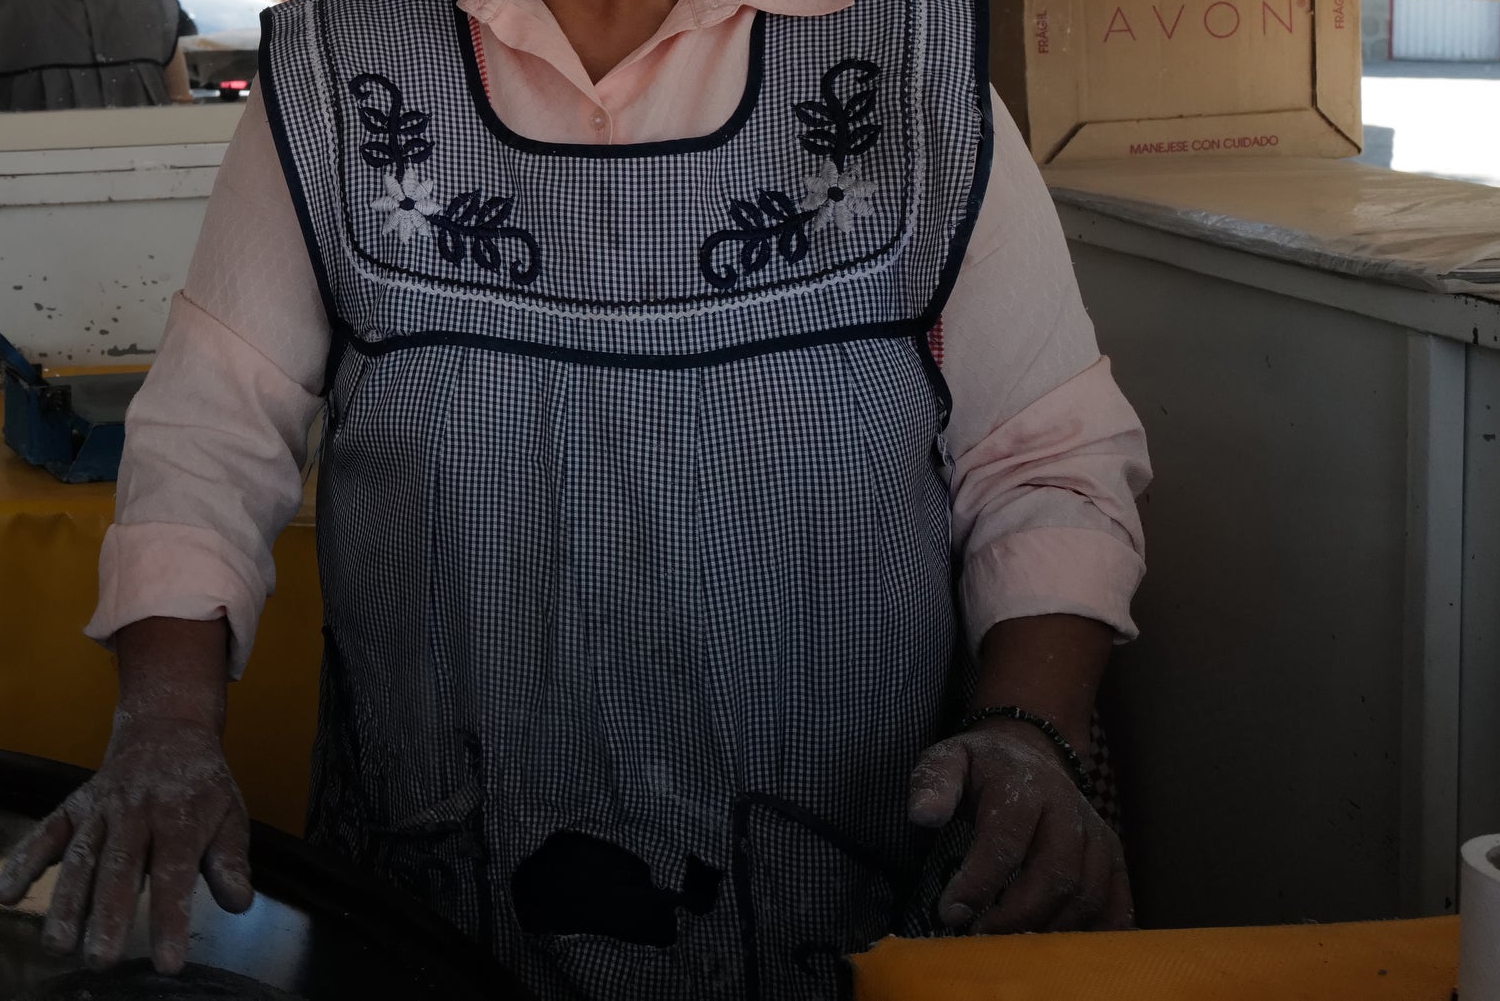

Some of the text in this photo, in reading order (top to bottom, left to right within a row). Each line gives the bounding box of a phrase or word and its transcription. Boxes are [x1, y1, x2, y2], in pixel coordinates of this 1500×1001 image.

[1103, 0, 1293, 42] AVON
[1130, 135, 1279, 155] MANEJESE CON CUIDADO
